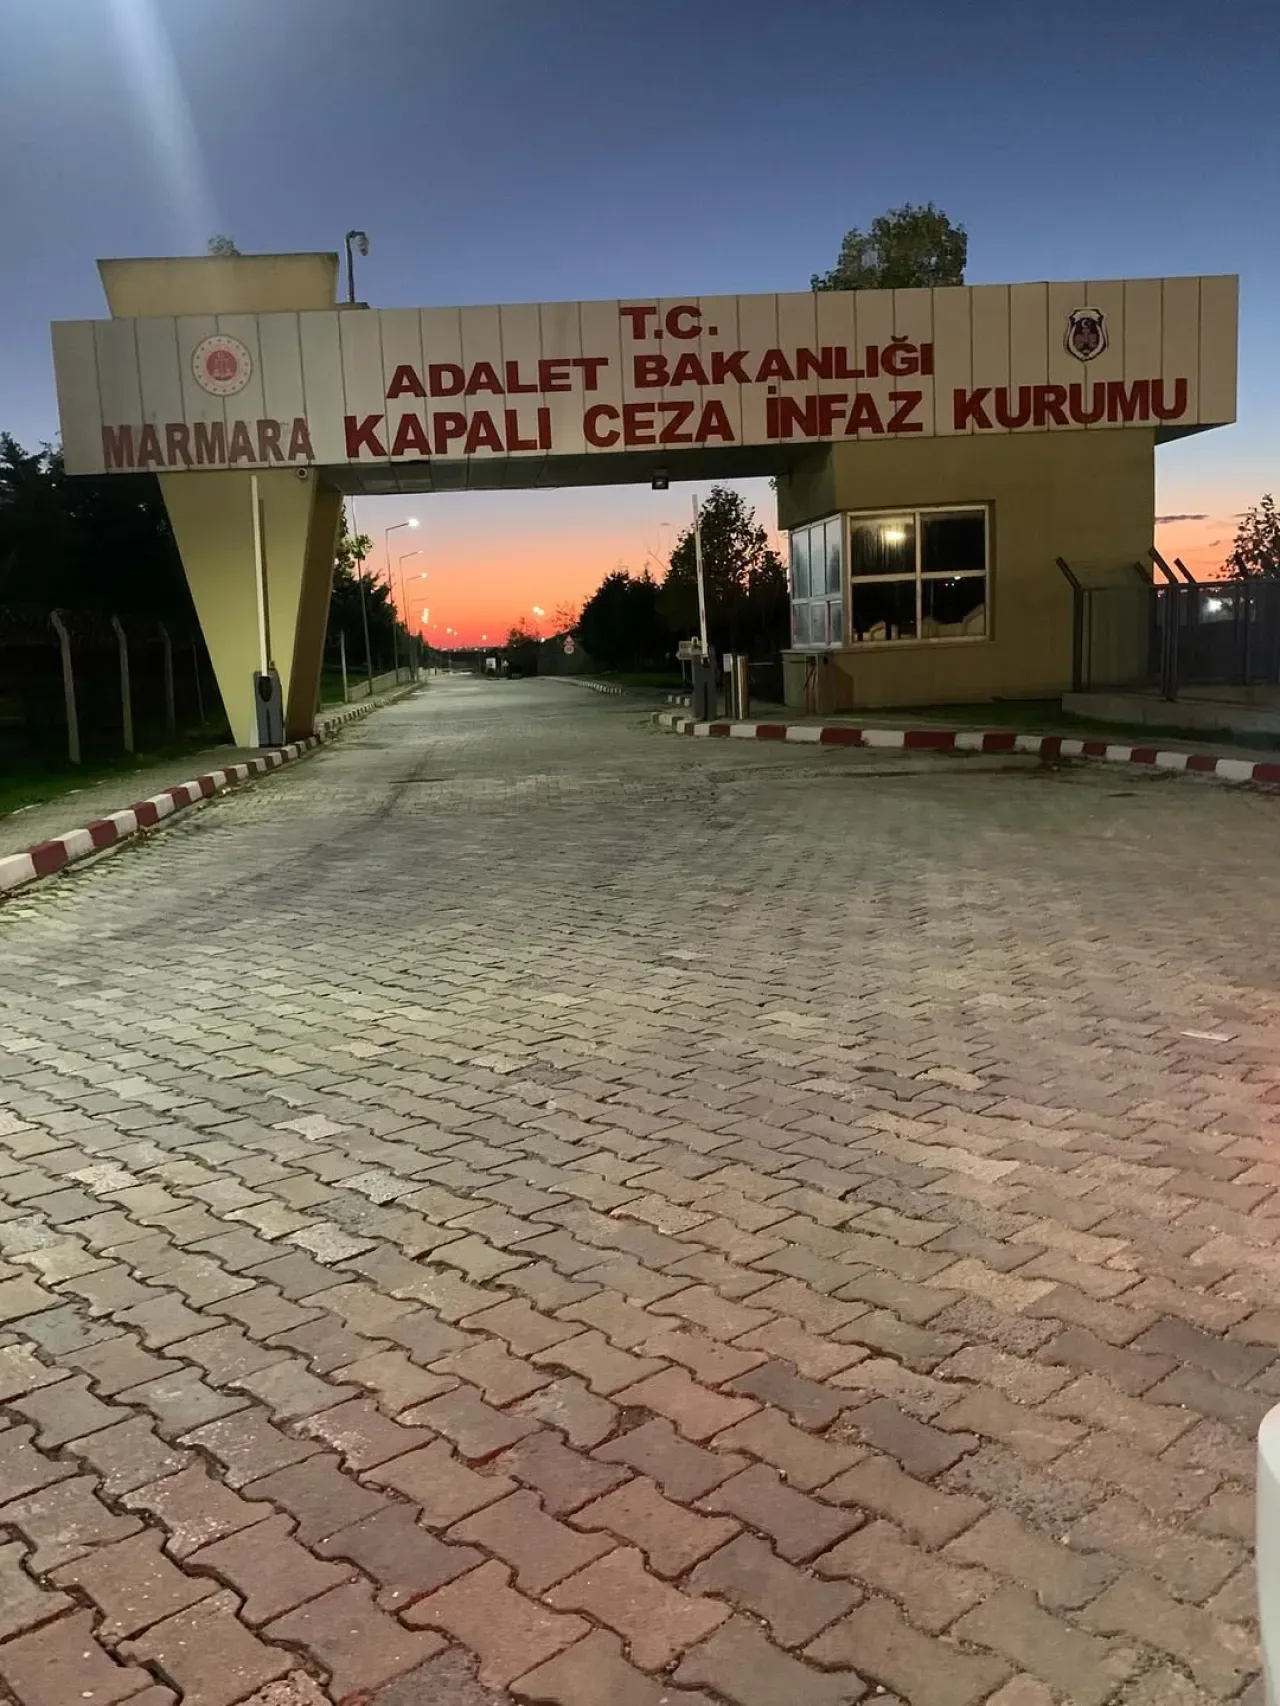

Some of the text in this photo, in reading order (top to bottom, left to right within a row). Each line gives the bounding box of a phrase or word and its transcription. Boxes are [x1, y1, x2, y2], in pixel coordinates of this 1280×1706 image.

[620, 305, 718, 340] T.C.
[385, 335, 935, 399] ADALET BAKANLIĞI
[103, 377, 1189, 469] MARMARA KAPALI CEZA İNFAZ KURUMU
